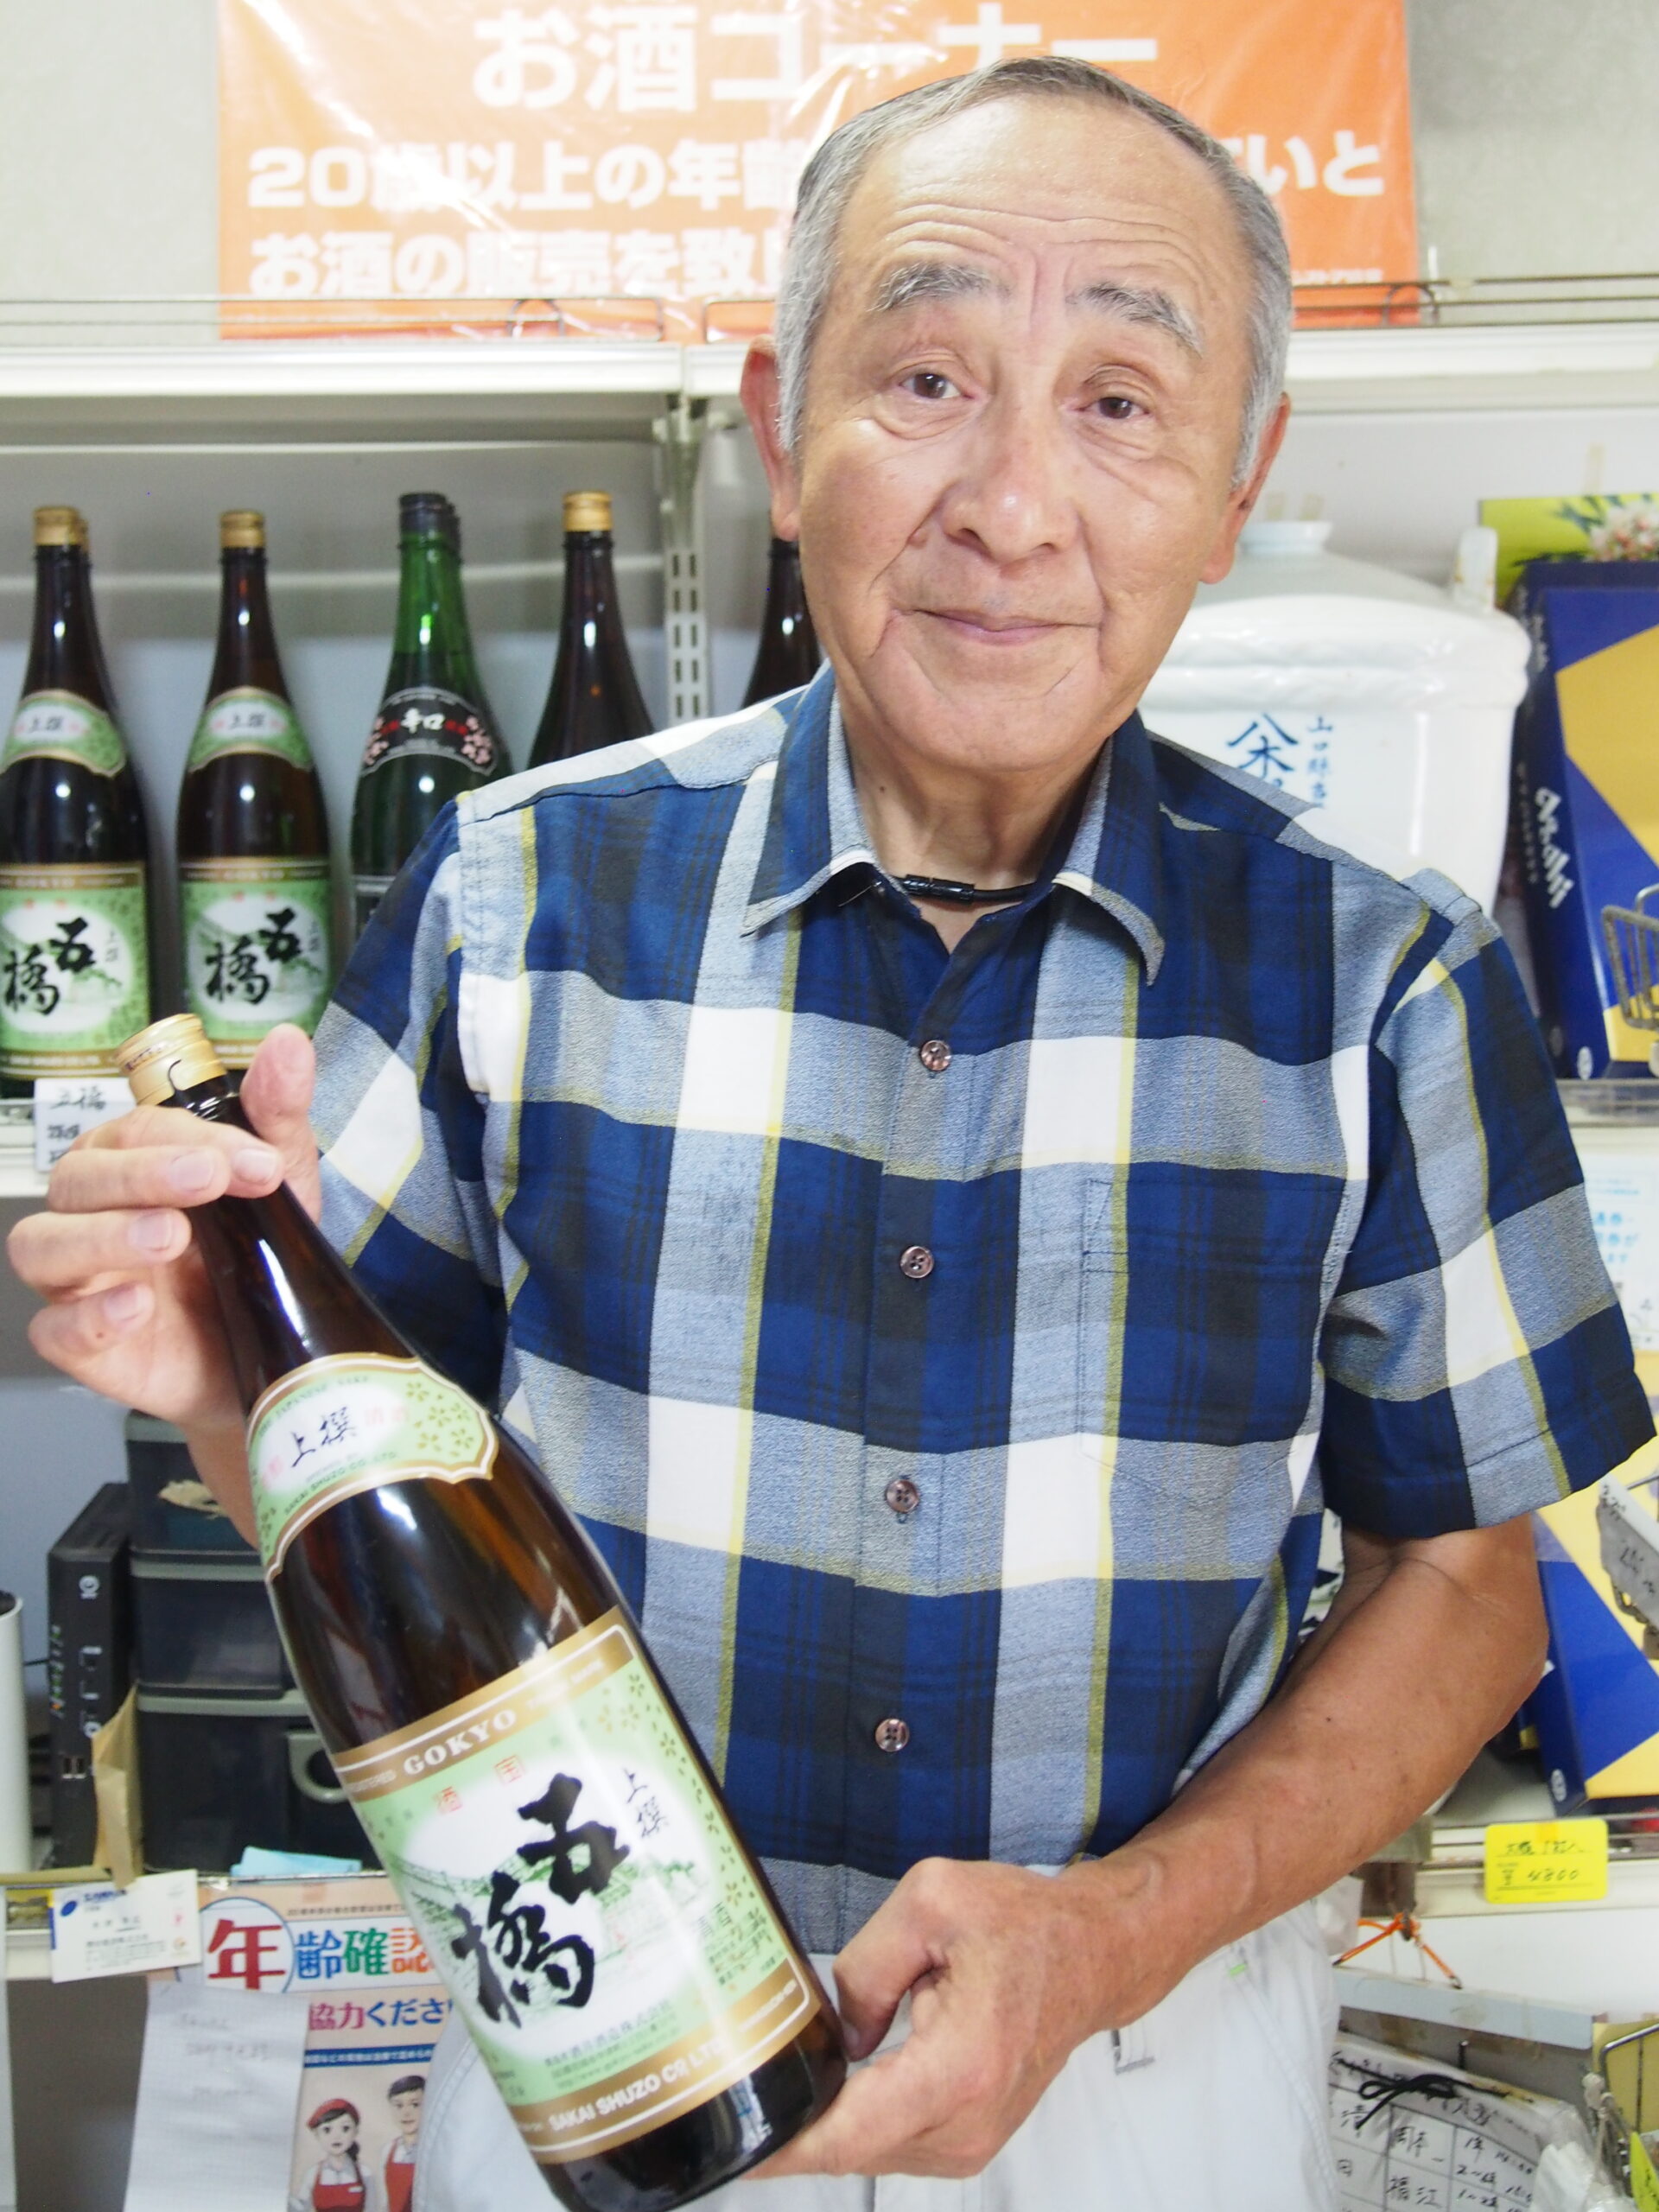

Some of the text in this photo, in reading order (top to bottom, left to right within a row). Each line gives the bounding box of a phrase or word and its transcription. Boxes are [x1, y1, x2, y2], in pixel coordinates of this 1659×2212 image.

[471, 2, 1158, 112] お酒コーナー
[1219, 130, 1384, 197] いと
[403, 1708, 517, 1776] GOKYO
[450, 1771, 631, 2030] 五橋
[548, 2102, 596, 2132] SAKAI
[596, 2072, 662, 2116] SHUZO
